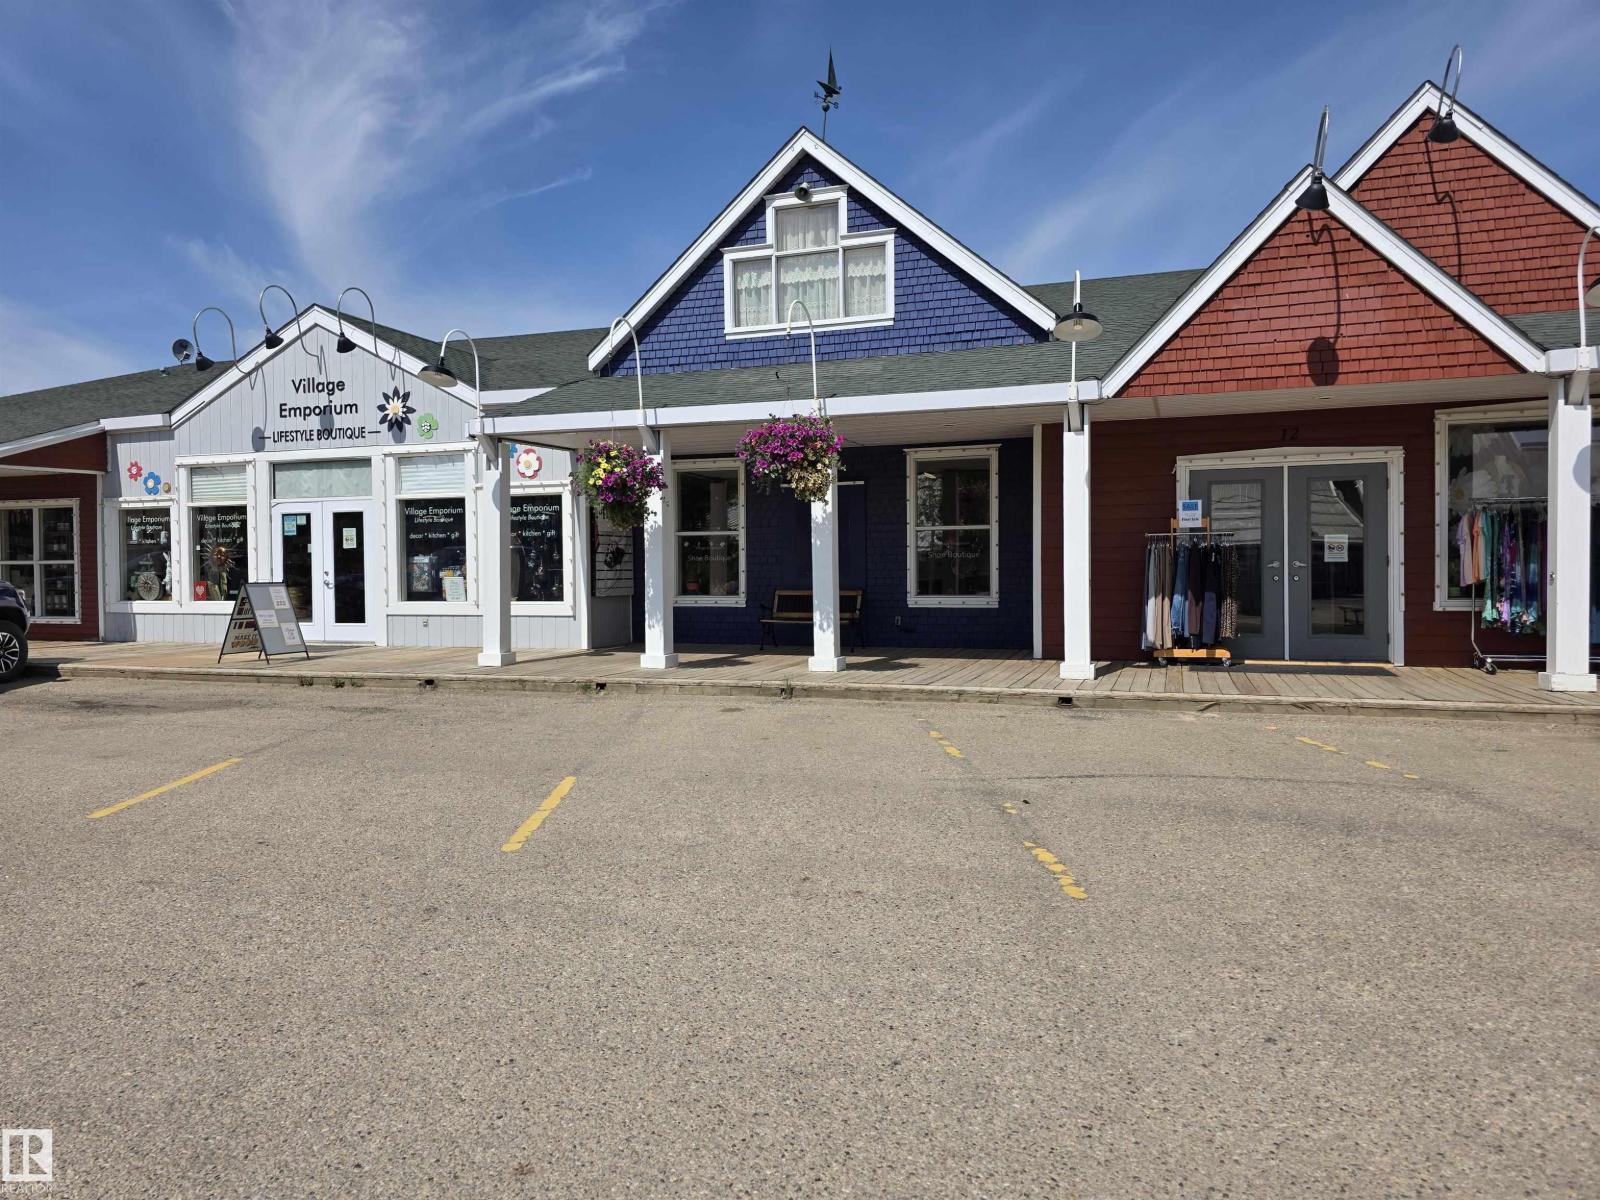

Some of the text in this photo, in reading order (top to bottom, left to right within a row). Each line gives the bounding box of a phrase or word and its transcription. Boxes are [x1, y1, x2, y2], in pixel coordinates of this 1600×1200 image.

[291, 376, 346, 396] Village
[279, 399, 359, 421] Emporium
[273, 426, 366, 443] LIFESTYLE BOUTIQUE
[404, 505, 464, 517] Village Emporium
[523, 503, 560, 514] Emporium
[196, 512, 247, 523] Village Emporium
[450, 531, 460, 539] gift
[523, 529, 542, 537] kitchen
[546, 529, 556, 538] gift
[927, 550, 981, 560] Shoe Boutique
